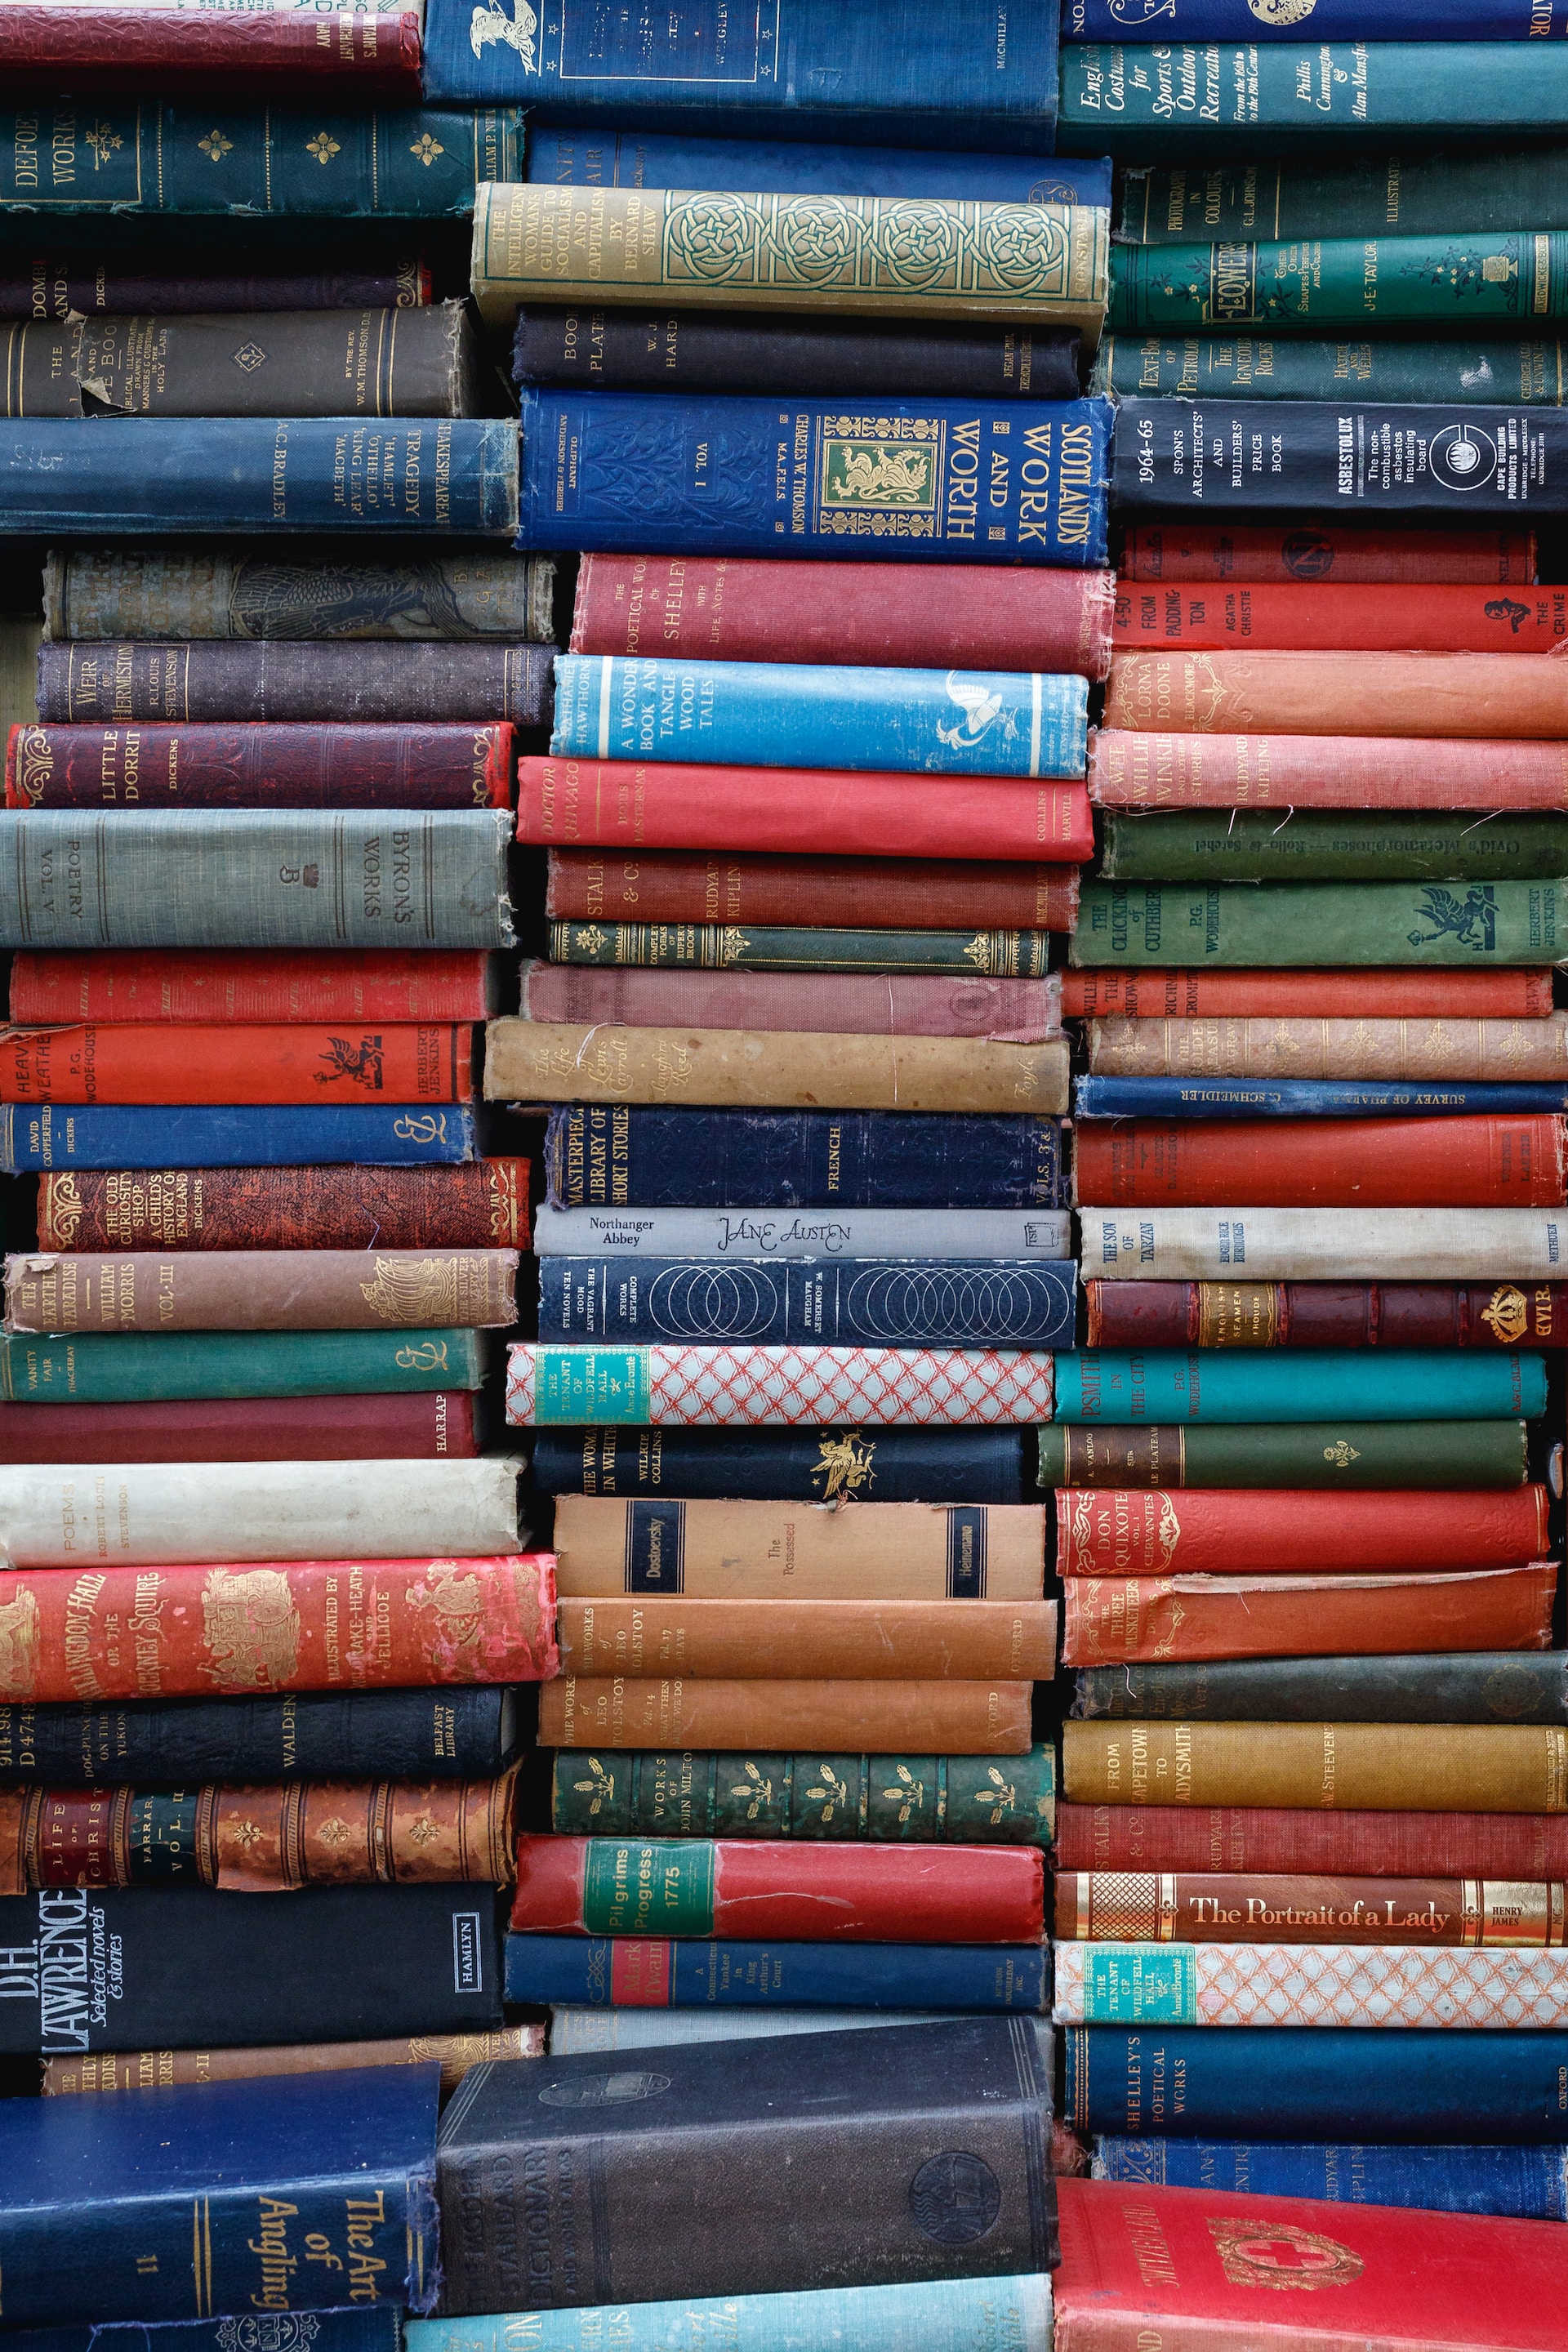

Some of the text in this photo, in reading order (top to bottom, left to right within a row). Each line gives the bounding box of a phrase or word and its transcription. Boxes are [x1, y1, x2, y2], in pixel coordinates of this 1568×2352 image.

[337, 13, 354, 60] MERCHANT
[363, 15, 377, 58] BRITAIN'S
[1152, 62, 1174, 118] Sports
[1296, 61, 1312, 102] Phillis
[541, 215, 557, 271] GUIDE
[555, 188, 572, 275] SOCIALISM
[572, 211, 587, 247] AND
[589, 188, 606, 280] CAPITALISM
[625, 196, 640, 271] BERNARD
[642, 206, 657, 256] SHAW
[791, 415, 808, 534] CHARLES THOMSON
[1138, 420, 1155, 483] 1964-65
[1174, 430, 1185, 474] SPON'S
[1212, 439, 1223, 467] AND
[1252, 434, 1263, 472] PRICE
[1272, 434, 1282, 473] BOOK
[1338, 417, 1354, 495] ASBESTOLUX
[1369, 459, 1379, 481] The
[1380, 423, 1392, 489] combustible
[1392, 431, 1403, 481] asbestos
[1404, 430, 1416, 483] insulating
[1416, 439, 1427, 471] board
[1497, 426, 1507, 491] CAPE BUILDING
[1508, 418, 1518, 500] PRODUCTS LIMITED
[947, 419, 981, 540] WORTH
[1018, 422, 1050, 546] WORK
[1060, 423, 1092, 545] SCOTLAND'S
[625, 587, 644, 653] POETICAL
[664, 559, 685, 640] SHELLEY
[697, 585, 706, 608] WITH
[1141, 596, 1156, 630] FROM
[1191, 602, 1205, 626] TON
[1226, 594, 1236, 631] AGATHA
[1241, 591, 1252, 636] CHRISTIE
[1537, 602, 1549, 626] THE
[113, 645, 135, 721] HERMISTON
[163, 650, 179, 717] STEVENSON
[621, 660, 638, 728] WONDER
[679, 676, 696, 730] WOOD
[699, 679, 715, 729] TALES
[1138, 663, 1152, 718] LORNA
[1156, 662, 1170, 719] DOONE
[1184, 663, 1196, 720] BLACKMORE
[640, 703, 655, 751] BOOK
[101, 730, 119, 800] LITTLE
[124, 730, 140, 800] DORRIT
[169, 739, 179, 791] DICKENS
[1257, 738, 1270, 798] KIPLING
[542, 767, 557, 836] DOCTOR
[563, 761, 581, 841] ZHIVAGO
[1037, 791, 1046, 841] COLLINS
[1195, 839, 1520, 856] Ovid's Metamorphoses Satchel
[68, 841, 82, 919] POETRY
[363, 836, 381, 918] WORKS
[393, 831, 413, 924] BYRON'S
[417, 1028, 429, 1095] HERBERT
[429, 1029, 440, 1095] JENKINS
[1180, 1089, 1465, 1103] SURVEY SCHMEIDLER
[29, 1121, 39, 1153] DAVID
[42, 1106, 52, 1167] COPPERFIELD
[66, 1118, 74, 1153] DICKENS
[827, 1127, 841, 1191] FRENCH
[590, 1134, 606, 1202] LIBRARY
[105, 1176, 119, 1236] THE OLD
[132, 1184, 145, 1227] SHOP
[149, 1174, 163, 1226] CHILD'S
[163, 1190, 176, 1245] HISTORY
[175, 1173, 189, 1237] ENGLAND
[194, 1179, 204, 1229] DICKENS
[589, 1218, 655, 1229] Northanger
[602, 1235, 639, 1244] Abbey
[719, 1218, 852, 1252] JANE AUSTEN
[1102, 1223, 1117, 1263] THE SON
[1139, 1223, 1155, 1262] TARZAN
[1548, 1224, 1558, 1263] METHUEN
[100, 1263, 116, 1321] WILLIAM
[119, 1263, 136, 1321] MORRIS
[563, 1294, 571, 1329] NOVELS
[577, 1286, 585, 1313] MOOD
[586, 1289, 595, 1332] VAGRANT
[629, 1276, 637, 1324] COMPLETE
[804, 1281, 813, 1326] MAUGHAM
[813, 1285, 822, 1334] SOMERSET
[26, 1350, 38, 1390] VANITY
[43, 1358, 53, 1382] FAIR
[1080, 1354, 1101, 1416] PSMITH
[434, 1396, 446, 1452] HARRAP
[1085, 1433, 1094, 1466] VANLOO
[639, 1434, 649, 1481] WILKIE
[652, 1431, 662, 1484] COLLINS
[62, 1483, 76, 1552] POEMS
[1097, 1509, 1111, 1551] DON
[1115, 1494, 1131, 1567] QUIXOTE
[1143, 1495, 1154, 1566] CERVANTES
[647, 1518, 666, 1578] Dostoevsky
[768, 1539, 781, 1559] The
[783, 1523, 795, 1575] Possessed
[960, 1526, 973, 1577] Heinemann
[1110, 1593, 1125, 1637] THREE
[616, 1629, 626, 1659] LEO
[282, 1694, 296, 1767] WALDEN
[434, 1705, 445, 1756] BELFAST
[445, 1708, 457, 1757] LIBRARY
[596, 1696, 608, 1726] LEO
[1106, 1744, 1120, 1789] FROM
[634, 1849, 653, 1928] Progress
[664, 1867, 681, 1909] 1775
[1492, 1907, 1523, 1916] HENRY
[1189, 1896, 1450, 1933] The Portrait of a Lady
[1493, 1918, 1520, 1927] JAMES
[39, 1888, 89, 2054] LAWRENCE
[90, 1906, 108, 2026] Selected novels
[460, 1922, 474, 1983] HAMLYN
[622, 1944, 642, 1992] Mark
[644, 1940, 662, 1996] Twain
[720, 1954, 733, 1990] Yankee
[746, 1961, 758, 1984] King
[772, 1960, 782, 1988] Court
[1097, 1975, 1107, 1998] THE
[1107, 1962, 1118, 2011] TENANT
[1127, 2037, 1140, 2129] SHELLEY'S
[1153, 2048, 1165, 2123] POETICAL
[1174, 2059, 1186, 2114] WORKS
[1559, 2067, 1567, 2109] OXFORD
[345, 2190, 387, 2300] The Art
[523, 2146, 554, 2303] DICTIONARY
[248, 2196, 300, 2309] Angling
